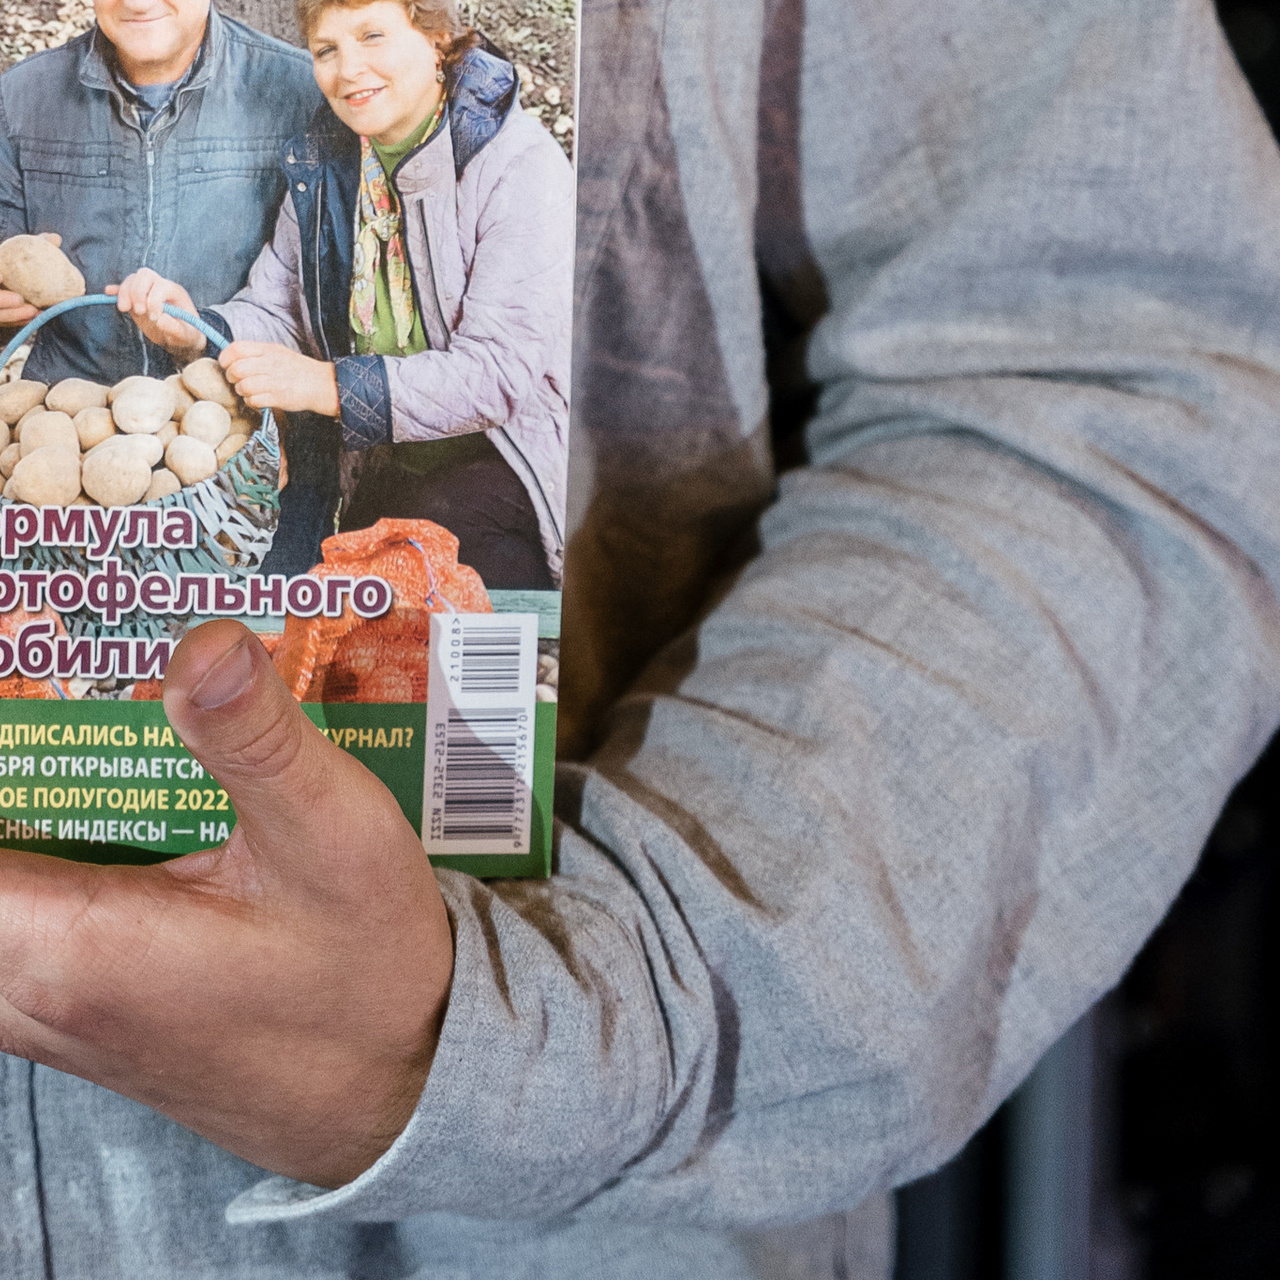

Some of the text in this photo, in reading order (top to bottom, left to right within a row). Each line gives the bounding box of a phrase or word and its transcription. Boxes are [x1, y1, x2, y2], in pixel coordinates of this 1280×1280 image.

[143, 726, 175, 747] НА
[40, 756, 204, 779] ОТКРЫВАЕТСЯ
[430, 722, 446, 841] ISSN 2312-2153
[33, 787, 170, 814] ПОЛУГОДИЕ
[174, 789, 229, 811] 2022
[58, 819, 167, 844] ИНДЕКСЫ
[199, 821, 230, 842] НА
